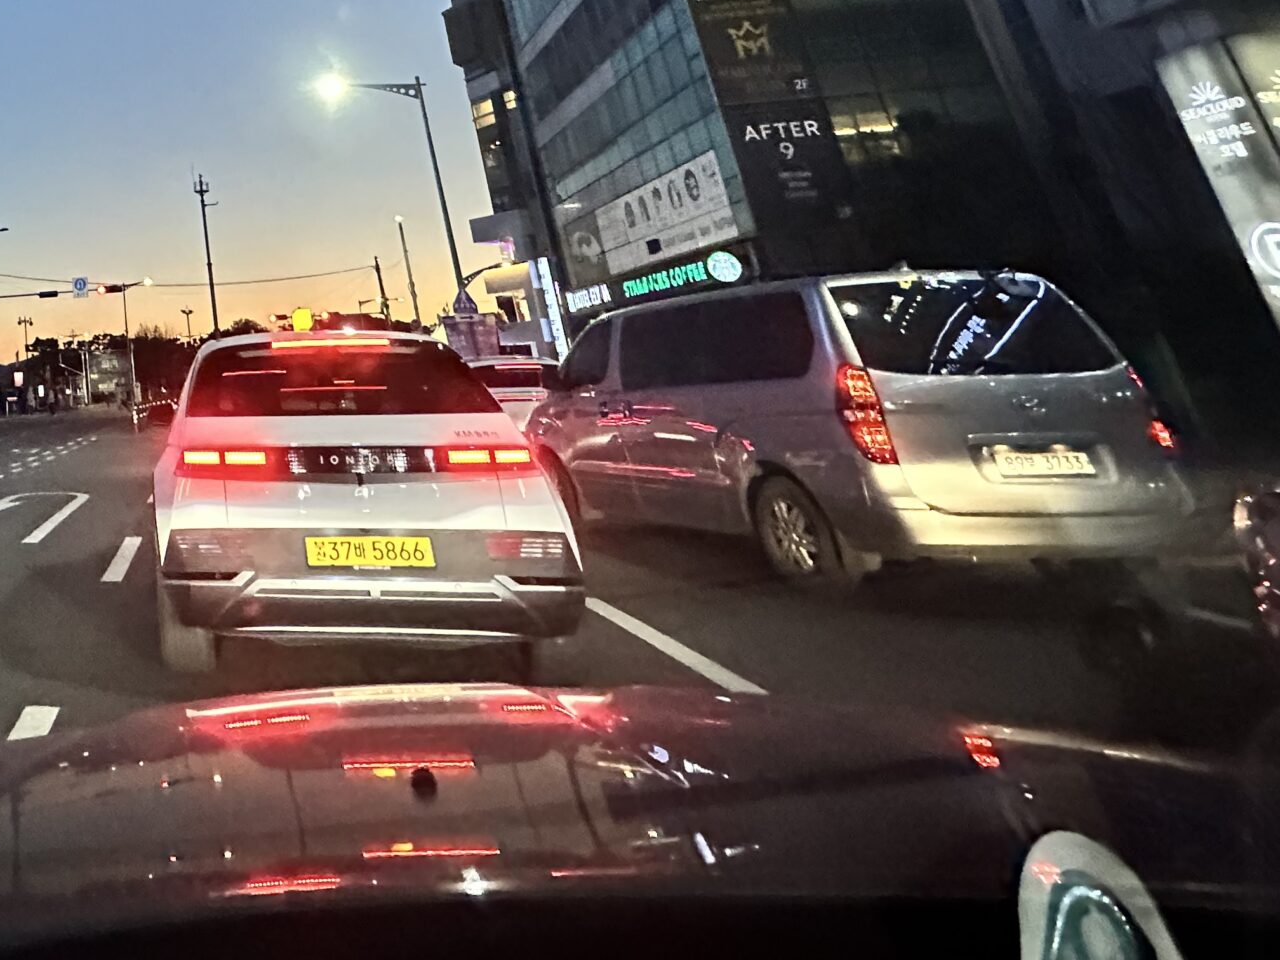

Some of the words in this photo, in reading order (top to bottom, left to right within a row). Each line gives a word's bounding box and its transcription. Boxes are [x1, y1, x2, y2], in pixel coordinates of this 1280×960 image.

[793, 78, 809, 90] 2F
[744, 120, 821, 142] AFTER
[778, 142, 795, 160] 9
[622, 267, 671, 298] STARBUCKS
[670, 260, 708, 288] COFFEE
[327, 541, 366, 561] 37바
[371, 540, 425, 561] 5866
